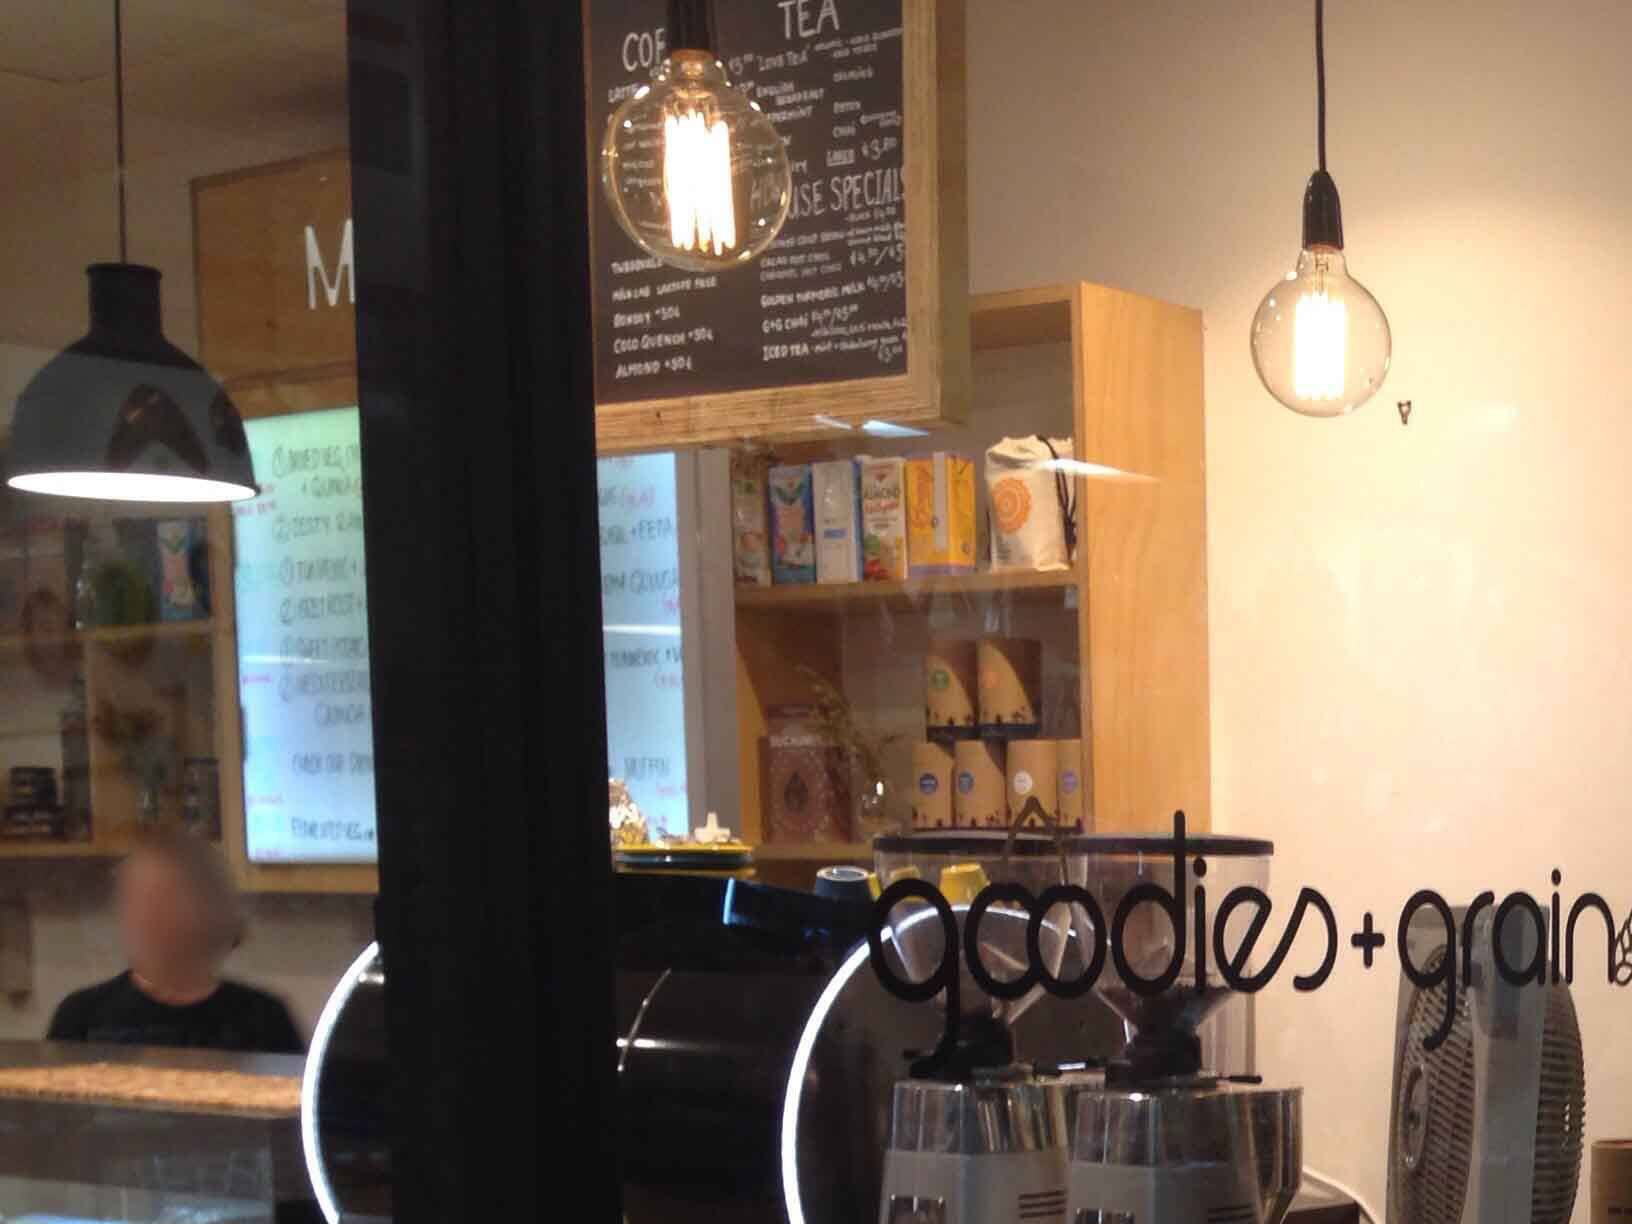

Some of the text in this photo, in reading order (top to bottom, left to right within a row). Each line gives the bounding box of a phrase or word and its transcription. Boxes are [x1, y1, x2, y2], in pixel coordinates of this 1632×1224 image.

[777, 0, 840, 39] TEA
[622, 28, 667, 72] COF
[830, 167, 904, 213] SPECIAL
